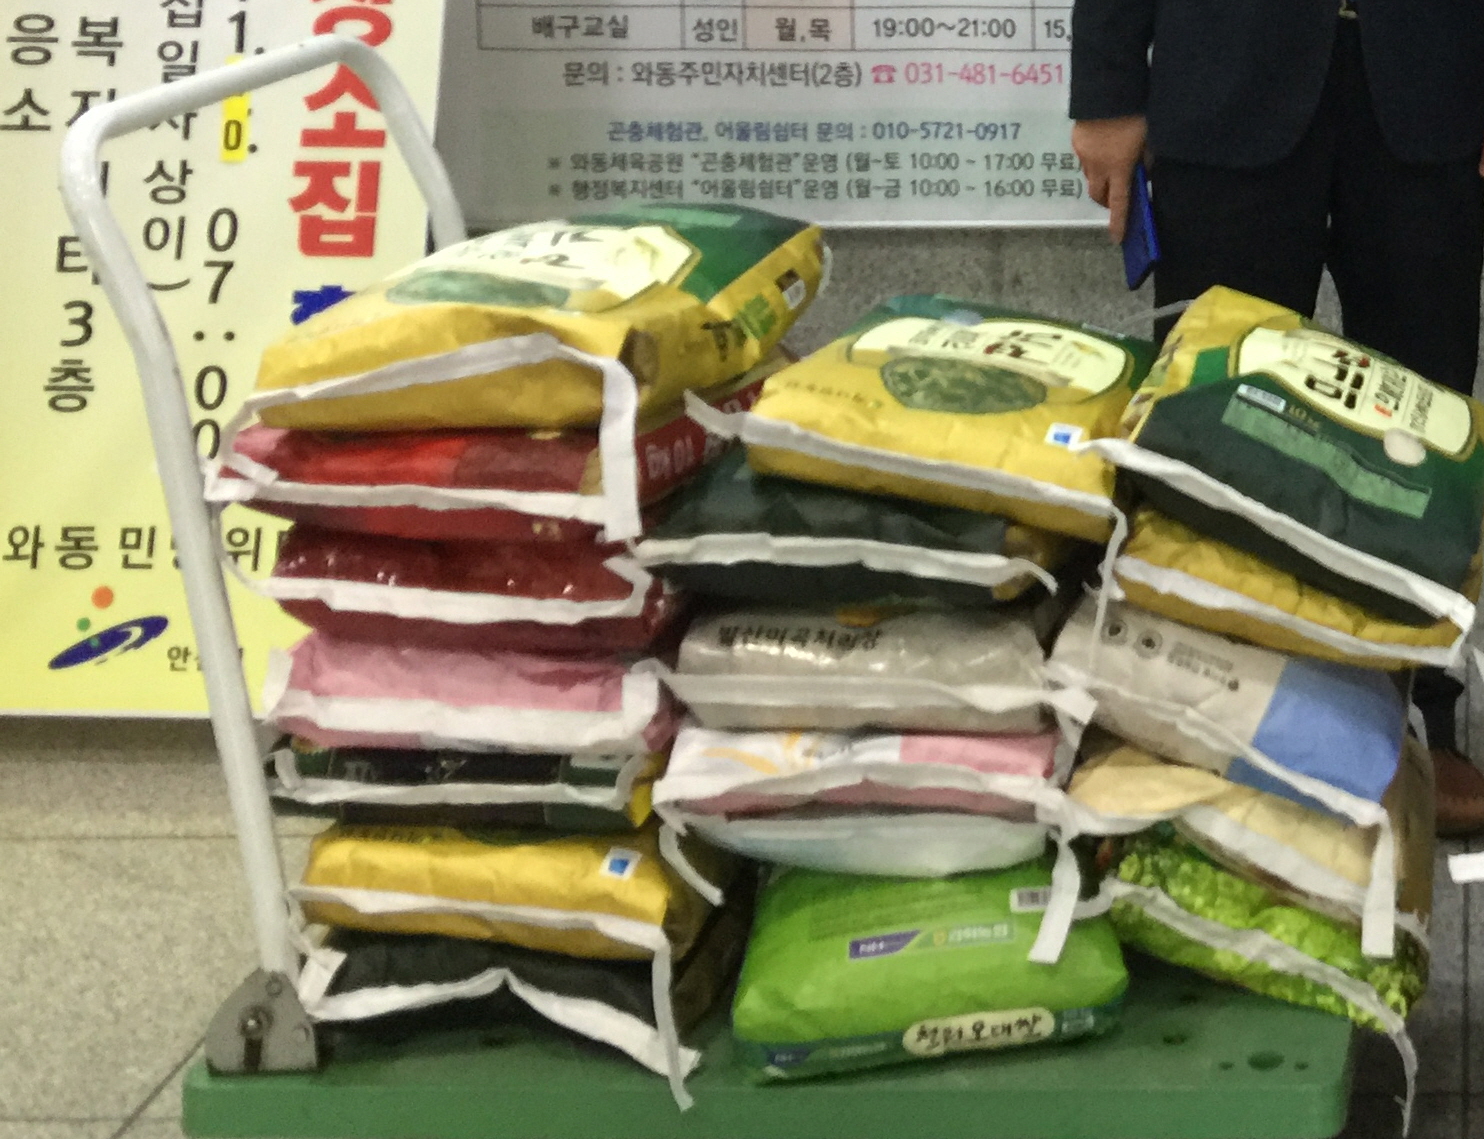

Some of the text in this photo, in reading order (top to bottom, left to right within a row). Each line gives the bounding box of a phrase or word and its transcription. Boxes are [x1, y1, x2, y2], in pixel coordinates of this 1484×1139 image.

[531, 14, 629, 39] 배구교실
[873, 18, 1016, 38] 19:00~21:00
[563, 61, 1063, 87] 문의 와동주민자치센터(2층) 031-481-6451
[817, 122, 853, 142] 문의
[873, 122, 1021, 141] 010-5721-0917
[910, 153, 959, 170] 10:00
[985, 153, 1034, 171] 17:00
[910, 179, 960, 197] 10:00
[985, 179, 1034, 197] 16:00
